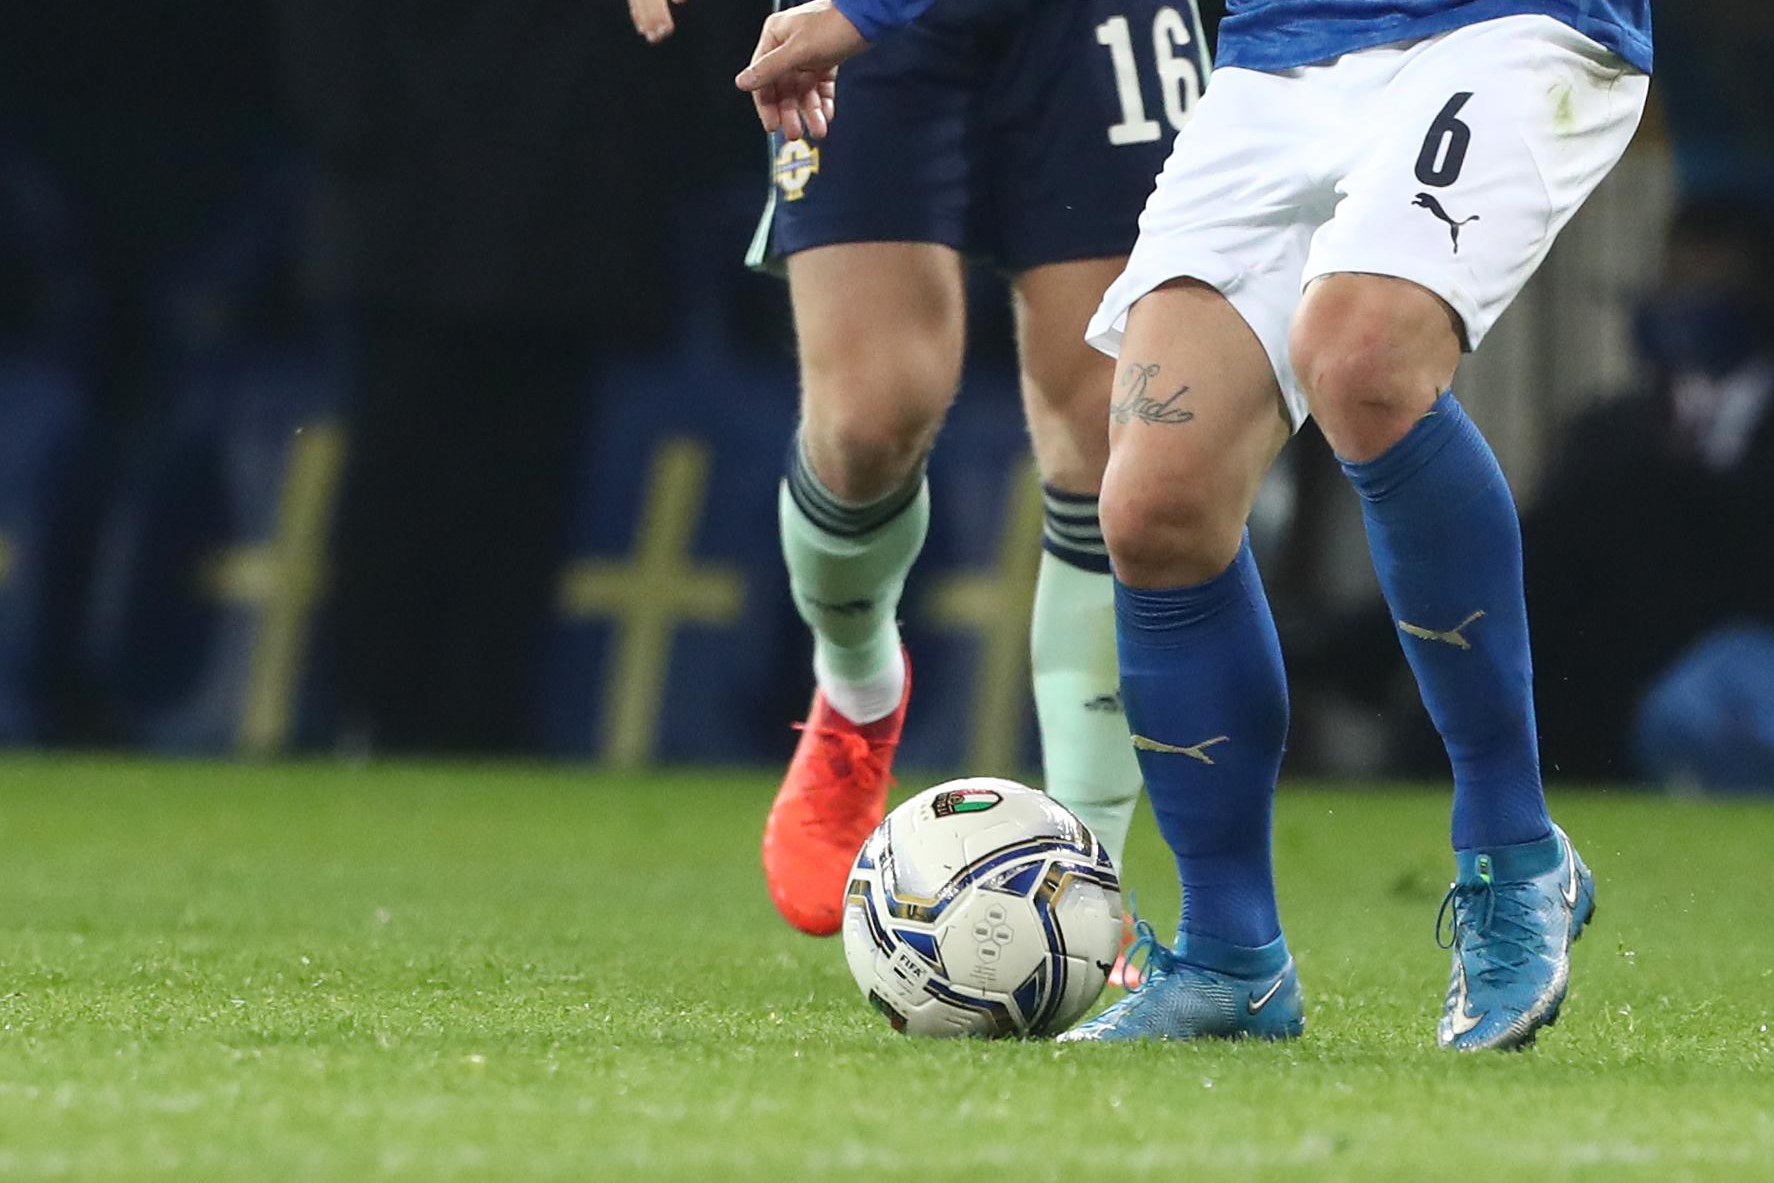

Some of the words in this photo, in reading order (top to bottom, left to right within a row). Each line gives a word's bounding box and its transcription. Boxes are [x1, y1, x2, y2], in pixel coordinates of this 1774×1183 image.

[1094, 5, 1201, 146] 16
[1413, 91, 1474, 188] 6
[900, 953, 921, 978] FIFA
